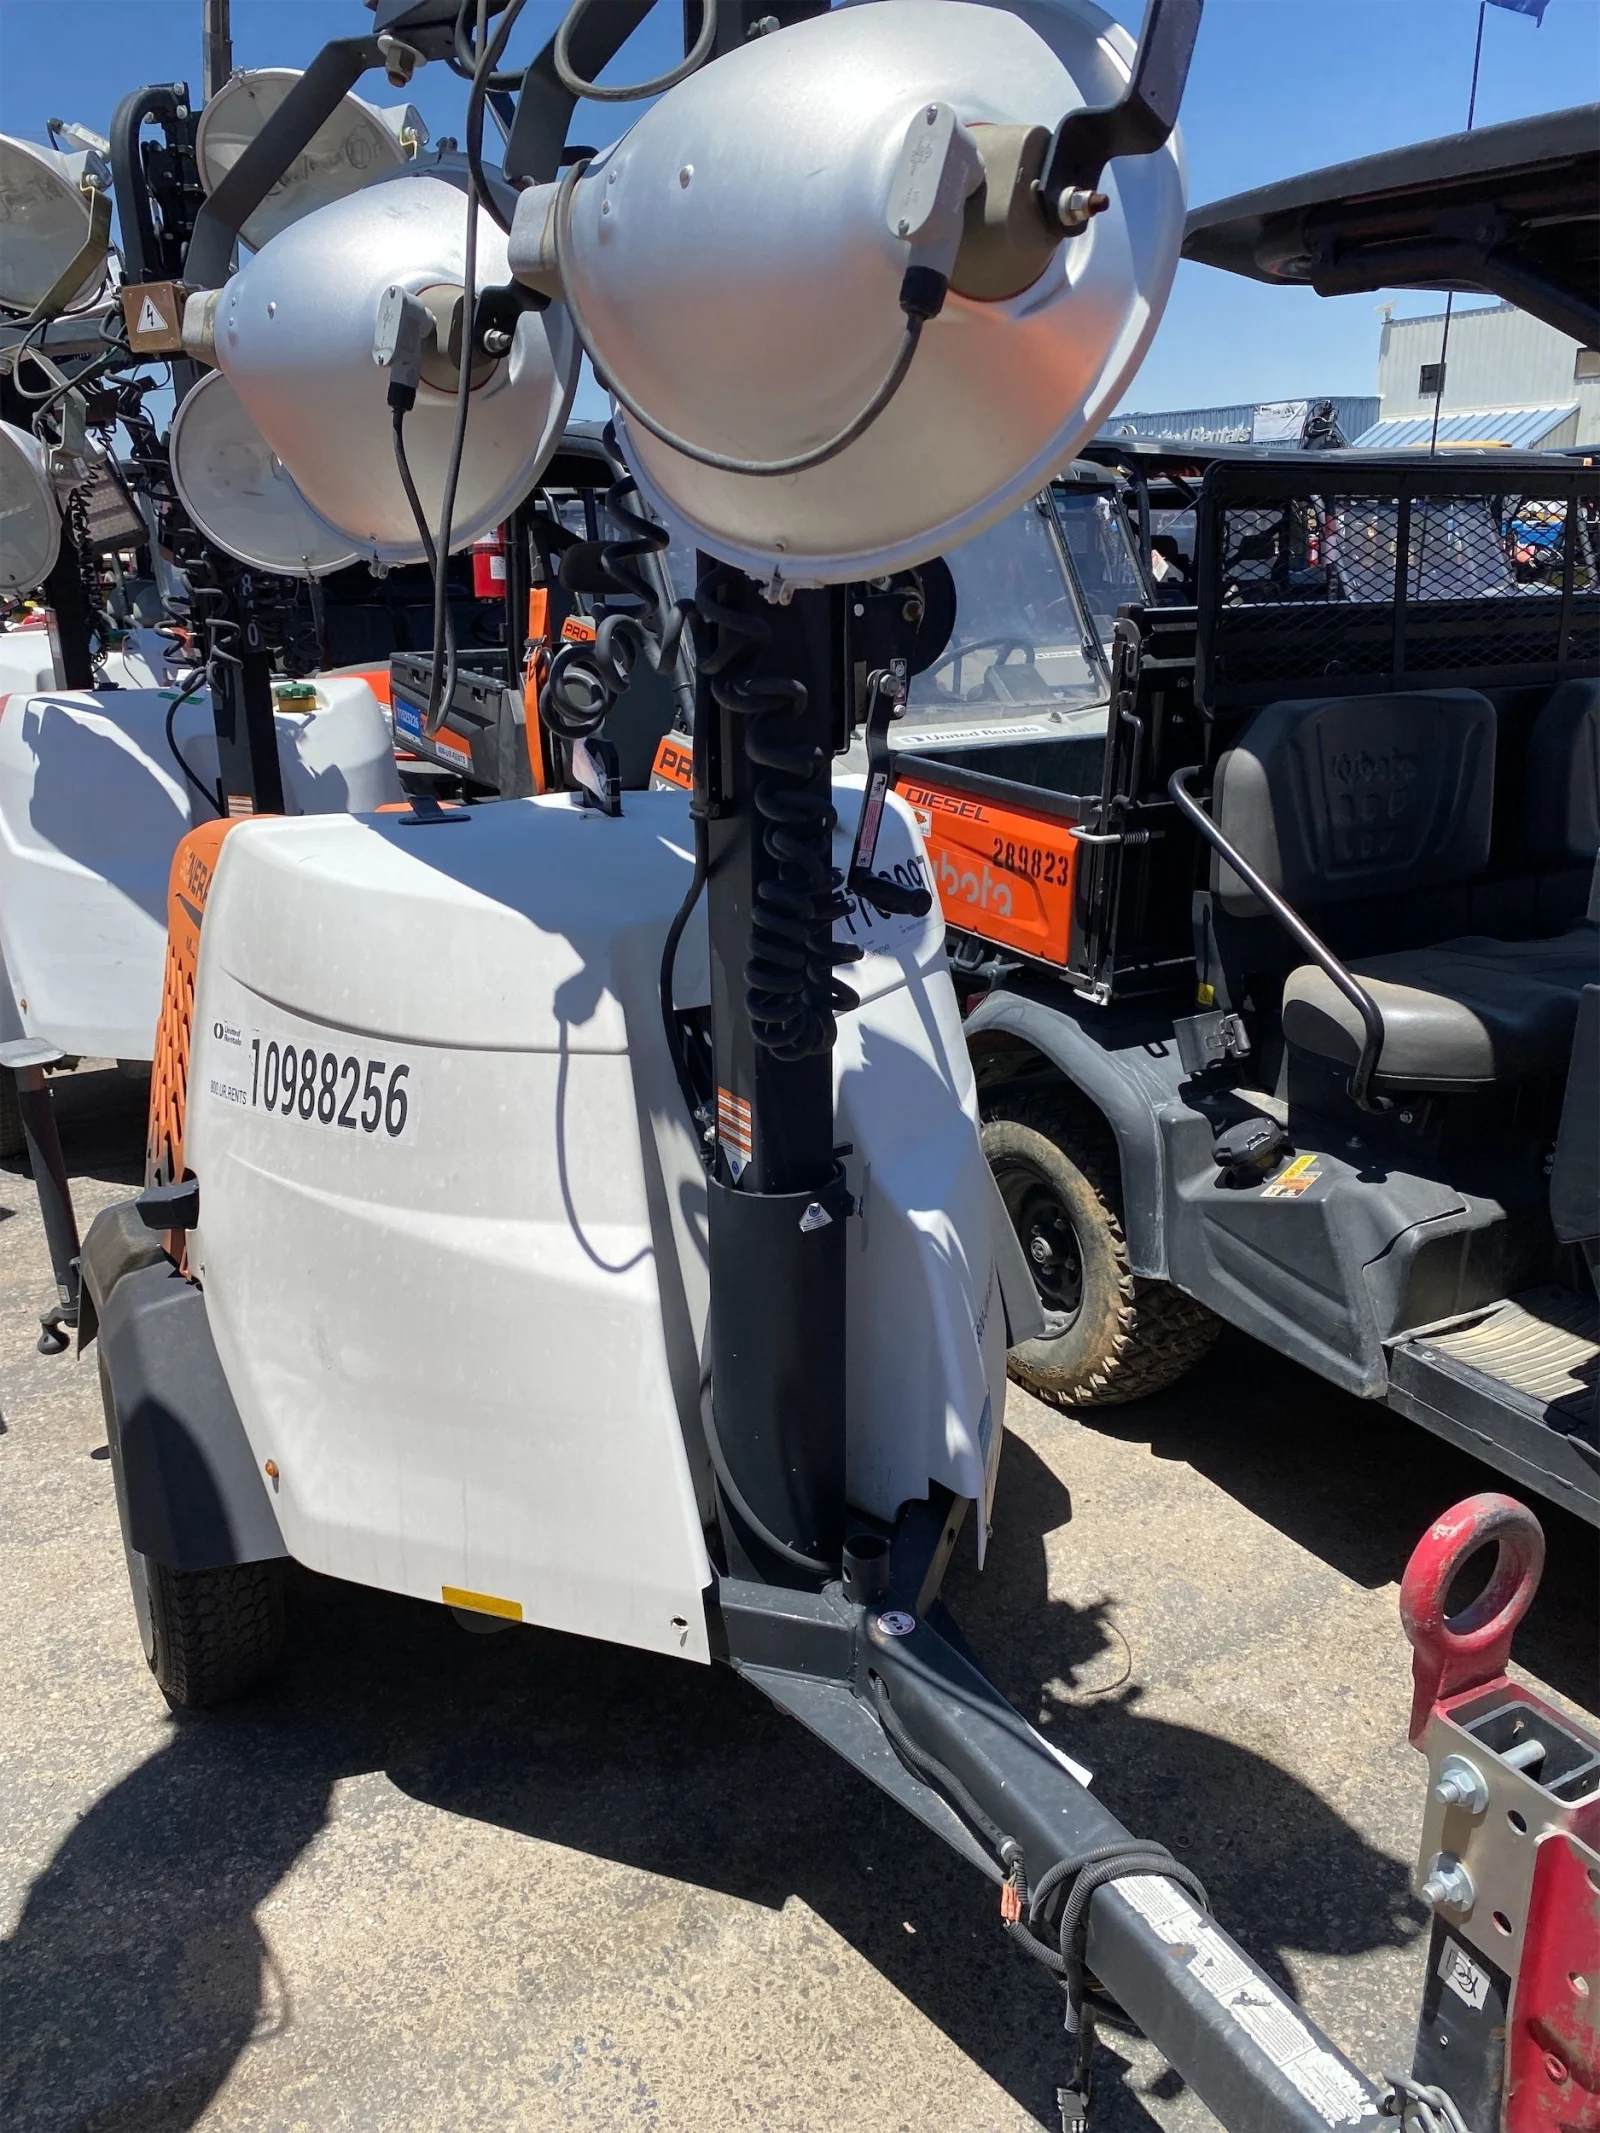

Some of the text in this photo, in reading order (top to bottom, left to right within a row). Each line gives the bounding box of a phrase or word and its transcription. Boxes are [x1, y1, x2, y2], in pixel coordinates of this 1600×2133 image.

[1191, 422, 1252, 443] Rentals
[565, 623, 589, 641] PRO
[925, 726, 1039, 742] United Rentals
[659, 747, 692, 783] PR
[904, 787, 990, 824] DIESEL
[991, 837, 1069, 887] 289823
[930, 850, 1013, 918] ubota
[224, 1025, 241, 1037] United
[224, 1033, 242, 1046] Rentals
[251, 1038, 411, 1138] 10988256
